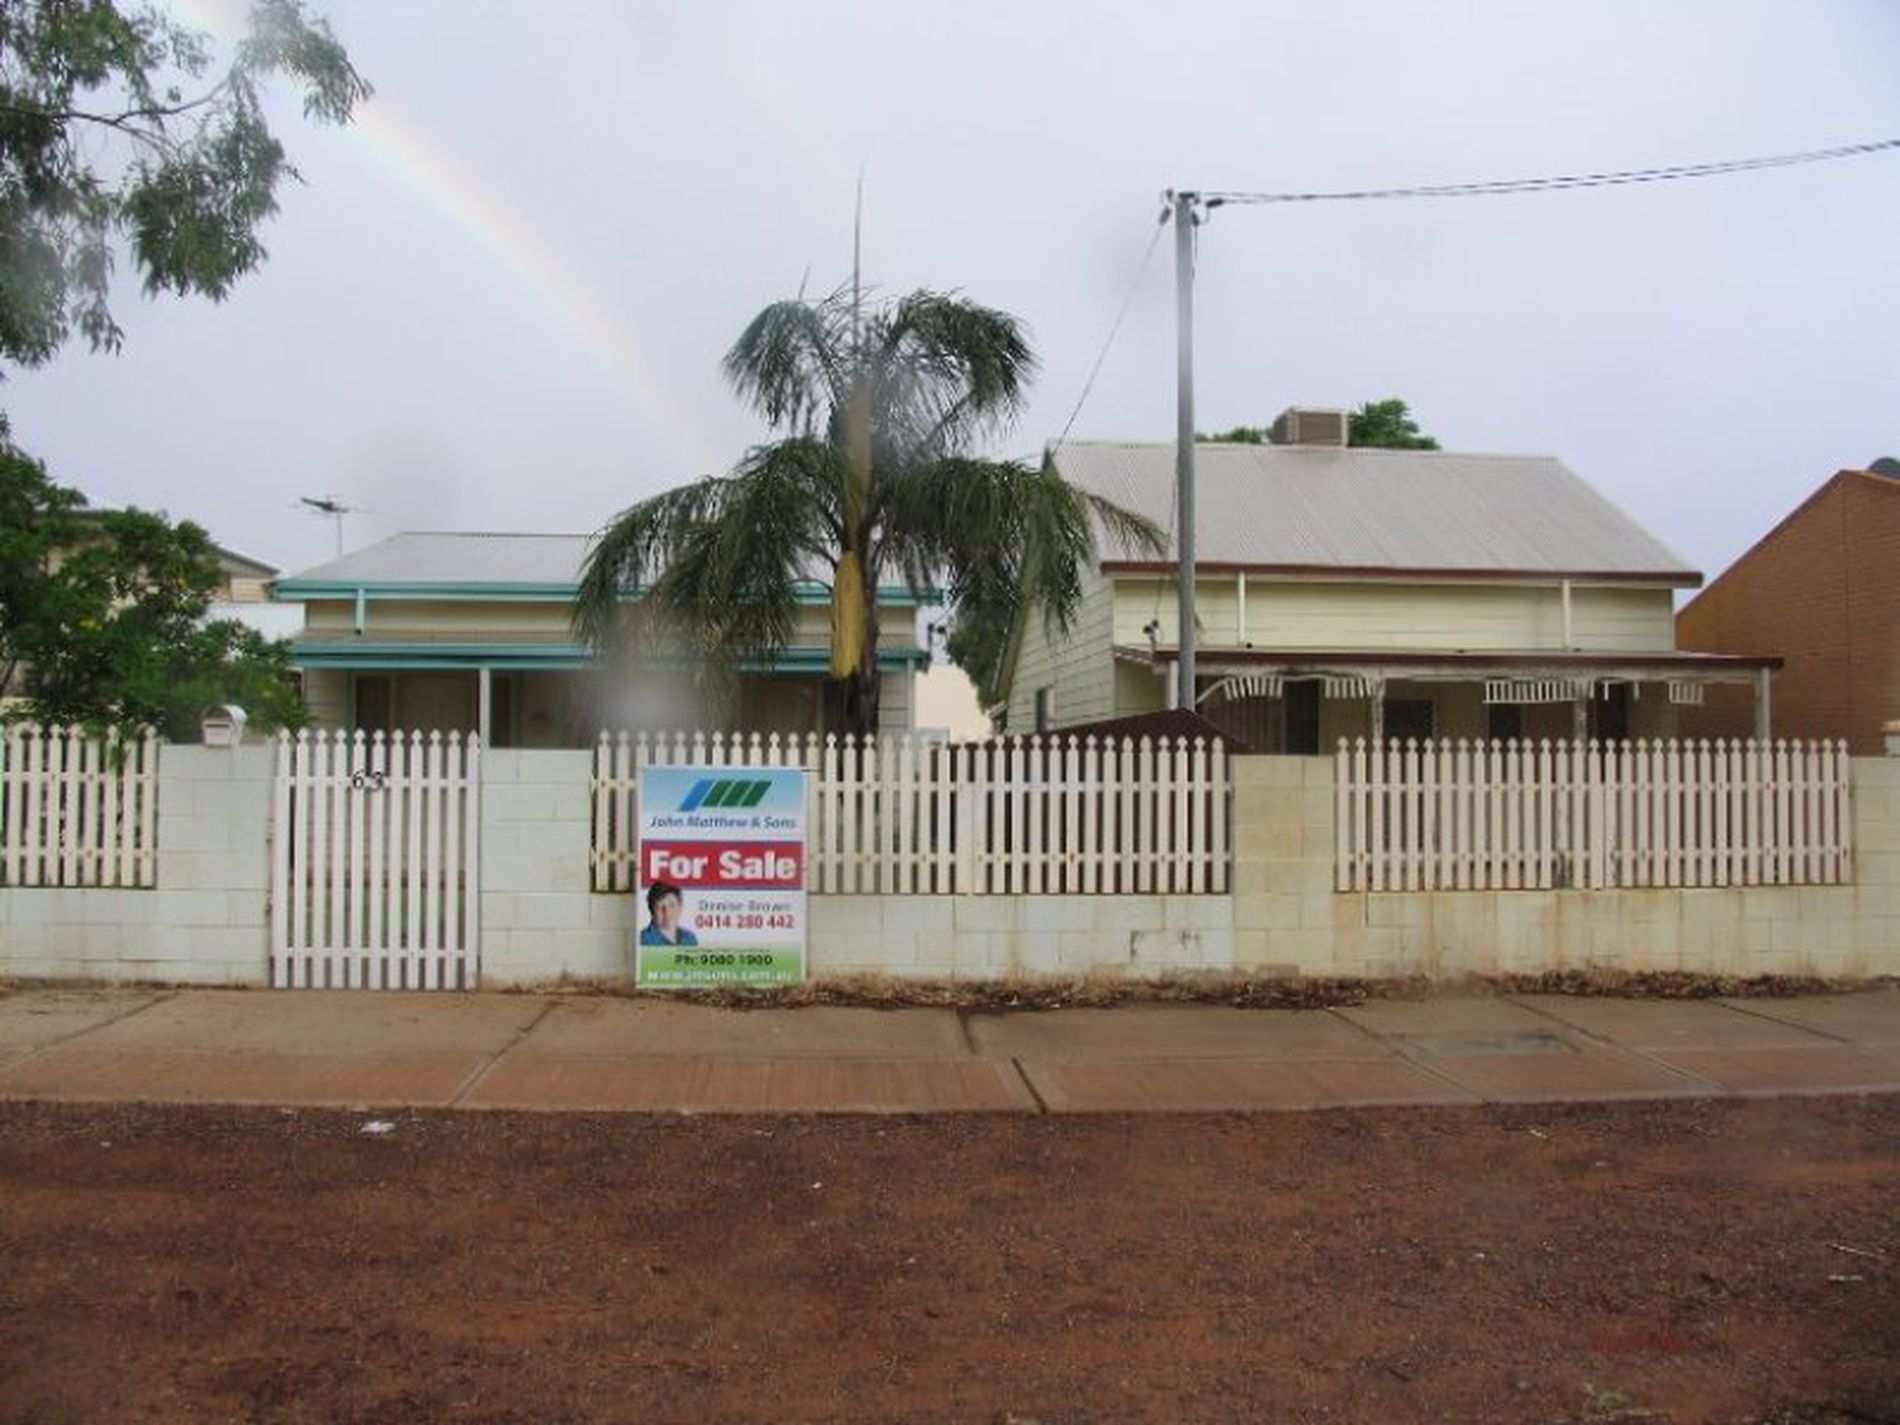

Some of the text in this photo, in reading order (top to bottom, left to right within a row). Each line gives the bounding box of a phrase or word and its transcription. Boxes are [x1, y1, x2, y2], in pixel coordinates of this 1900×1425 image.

[352, 769, 384, 792] 63
[649, 815, 797, 829] John Matthew & Sons
[649, 848, 797, 881] For Sale
[694, 913, 731, 929] 0414
[766, 914, 796, 929] 442
